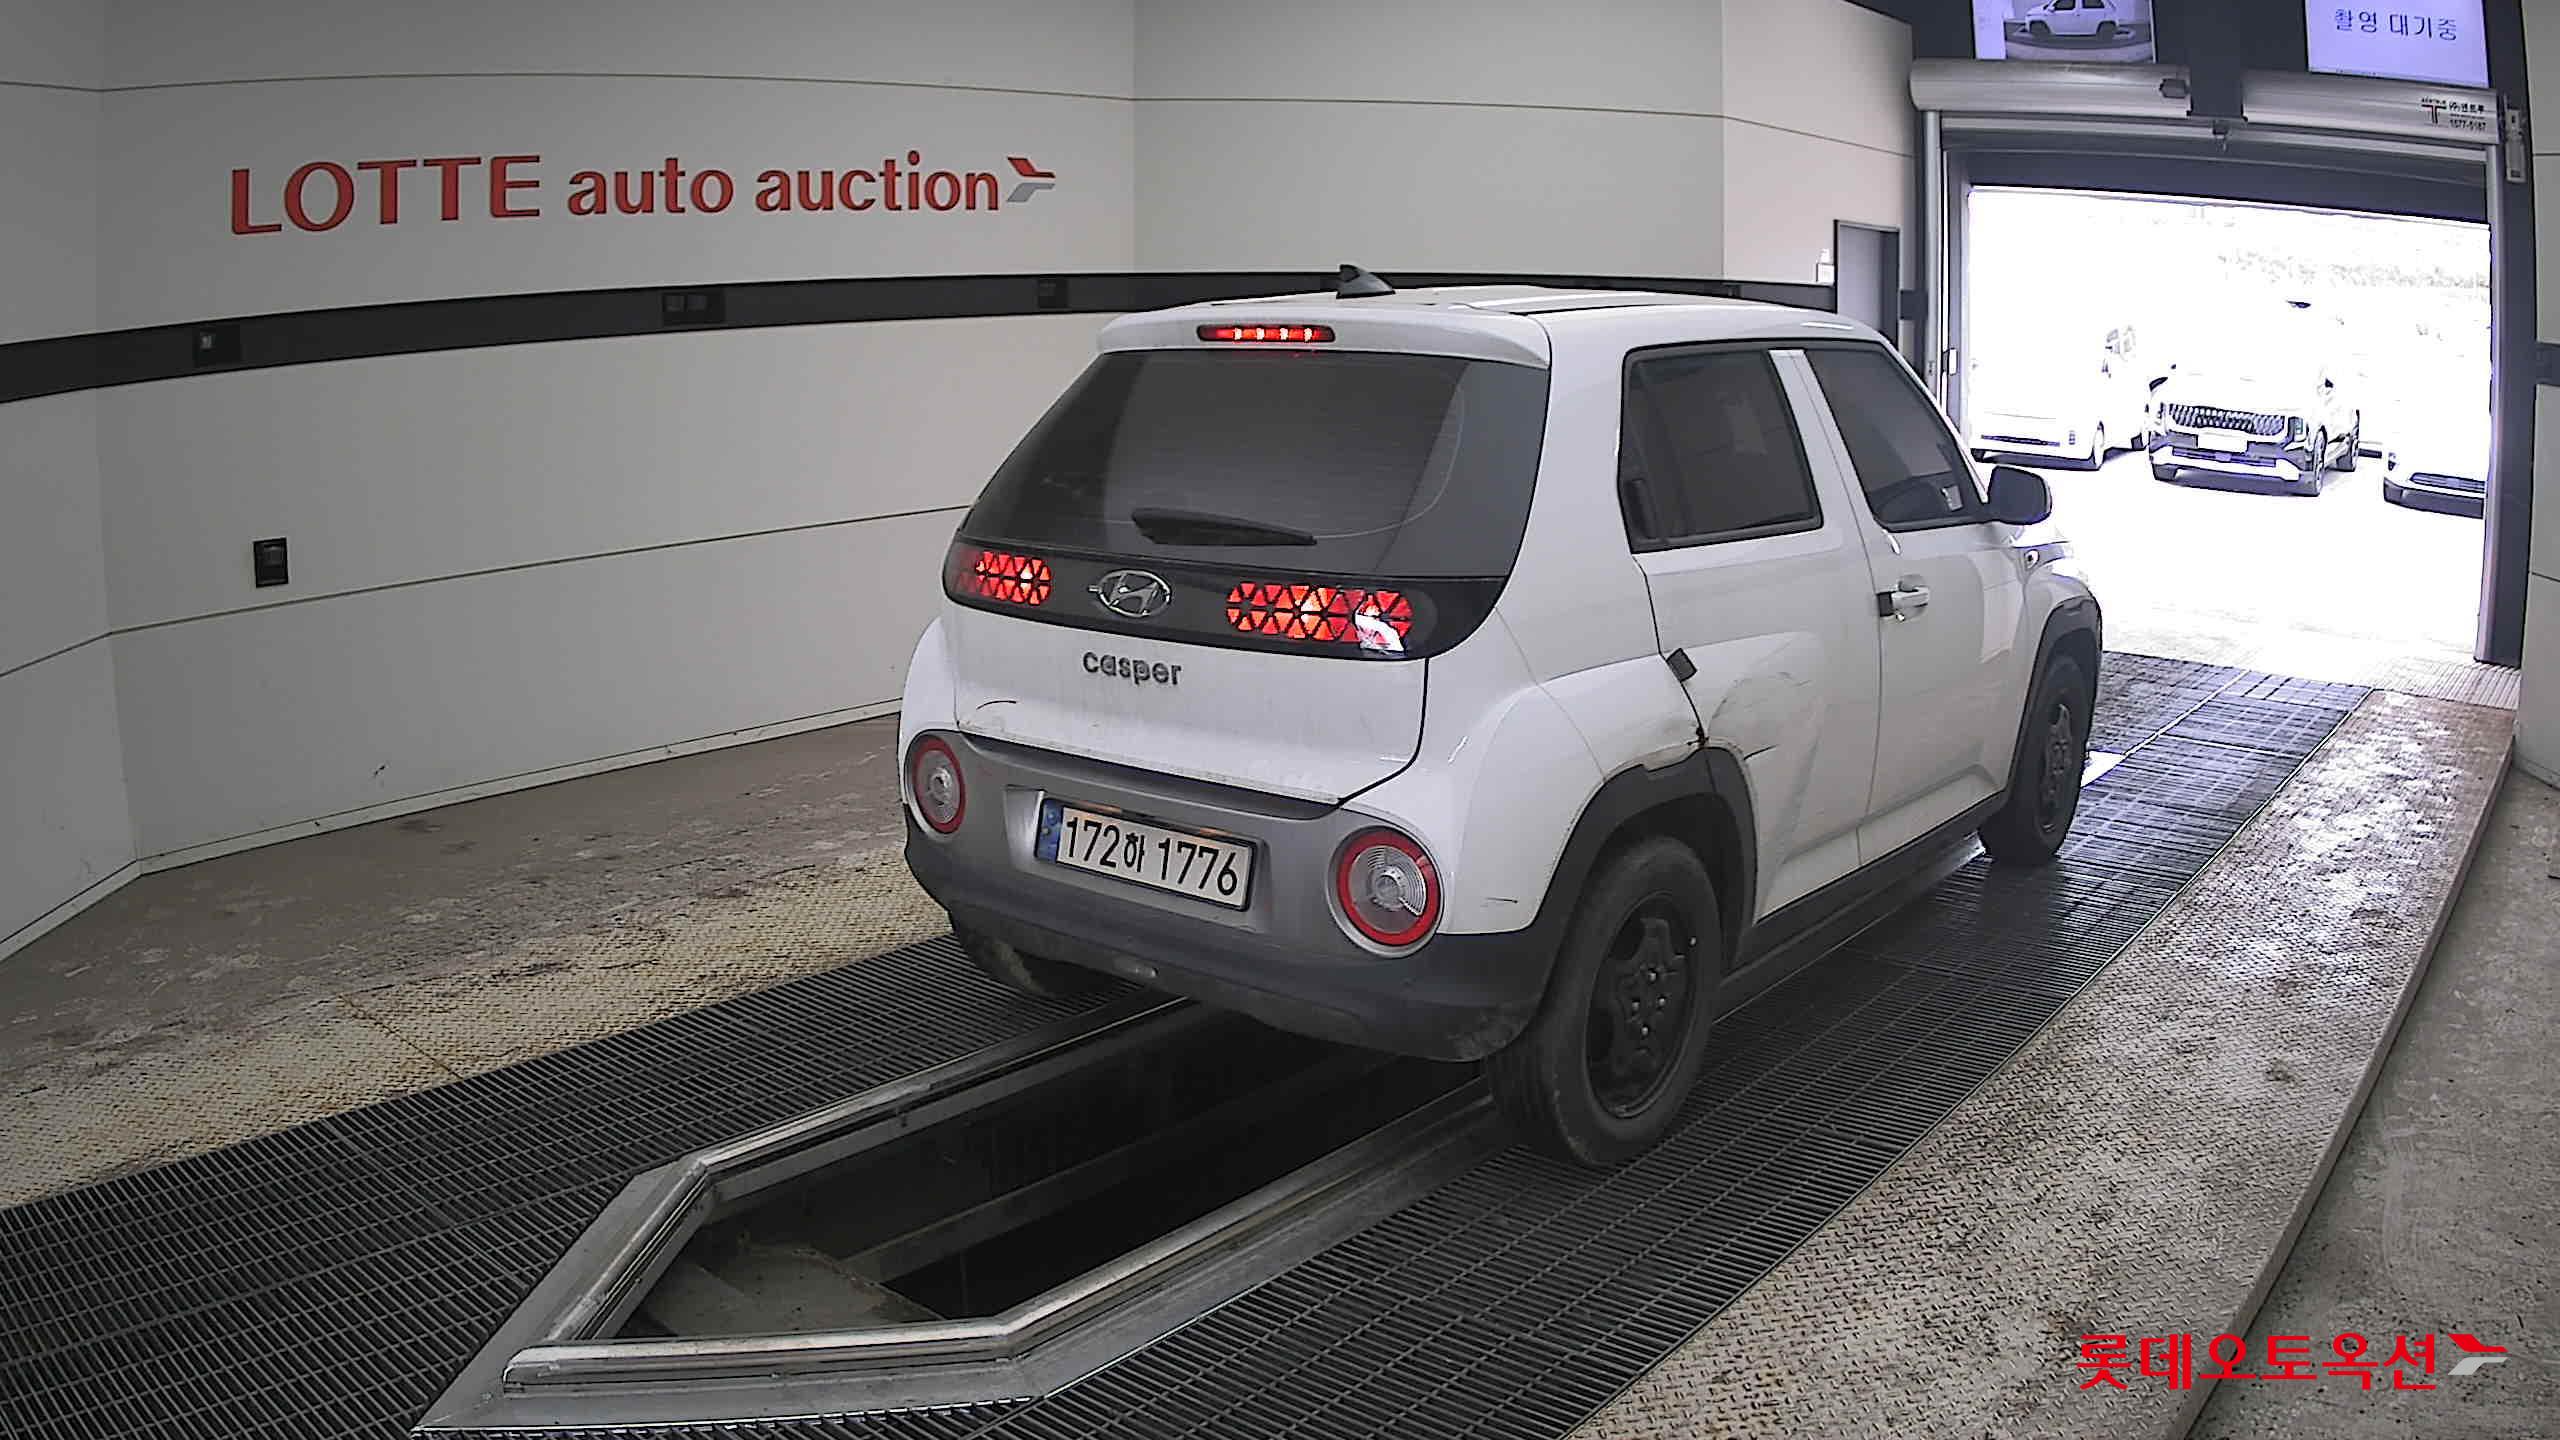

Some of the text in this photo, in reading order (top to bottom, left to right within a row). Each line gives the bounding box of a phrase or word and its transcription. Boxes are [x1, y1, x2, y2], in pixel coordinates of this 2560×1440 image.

[2389, 13, 2457, 41] 대기중
[231, 149, 999, 235] LOTTE auto auction
[1082, 651, 1182, 686] casper
[1066, 816, 1238, 896] 172하 1776
